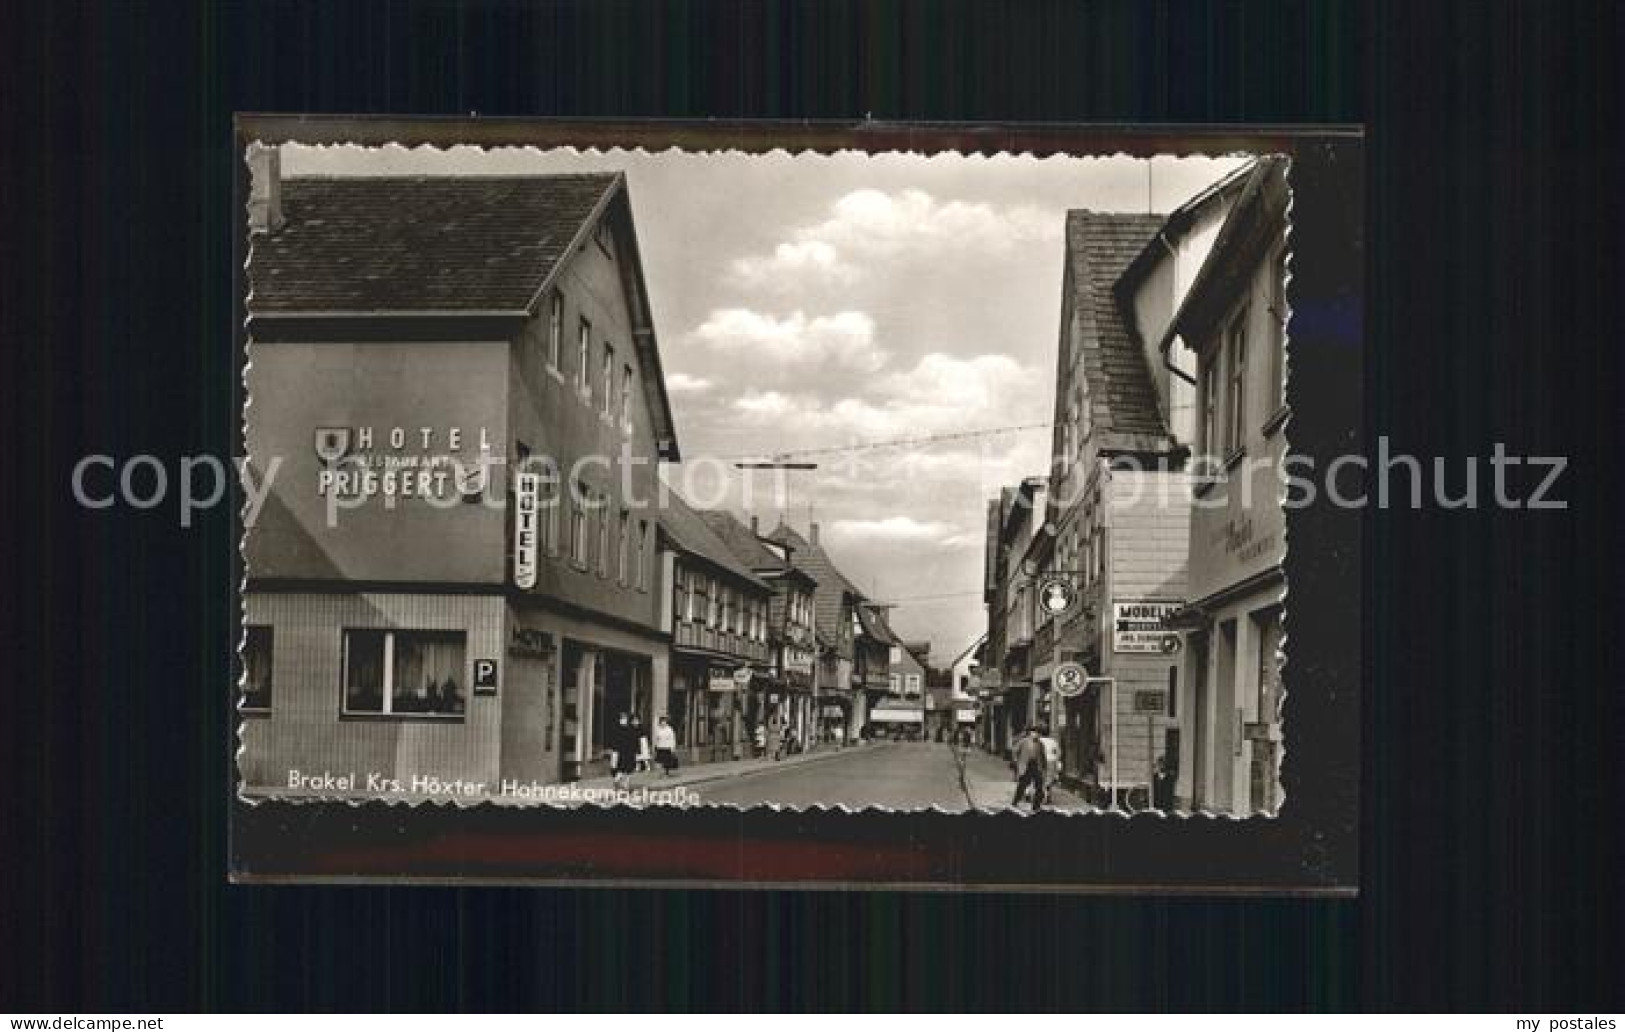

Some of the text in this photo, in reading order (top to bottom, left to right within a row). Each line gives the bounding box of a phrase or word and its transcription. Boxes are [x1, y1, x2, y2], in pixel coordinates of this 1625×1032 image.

[359, 426, 491, 449] HOTEL
[318, 470, 448, 496] PRIGGERT
[520, 477, 535, 567] HOTEL
[477, 663, 493, 683] P
